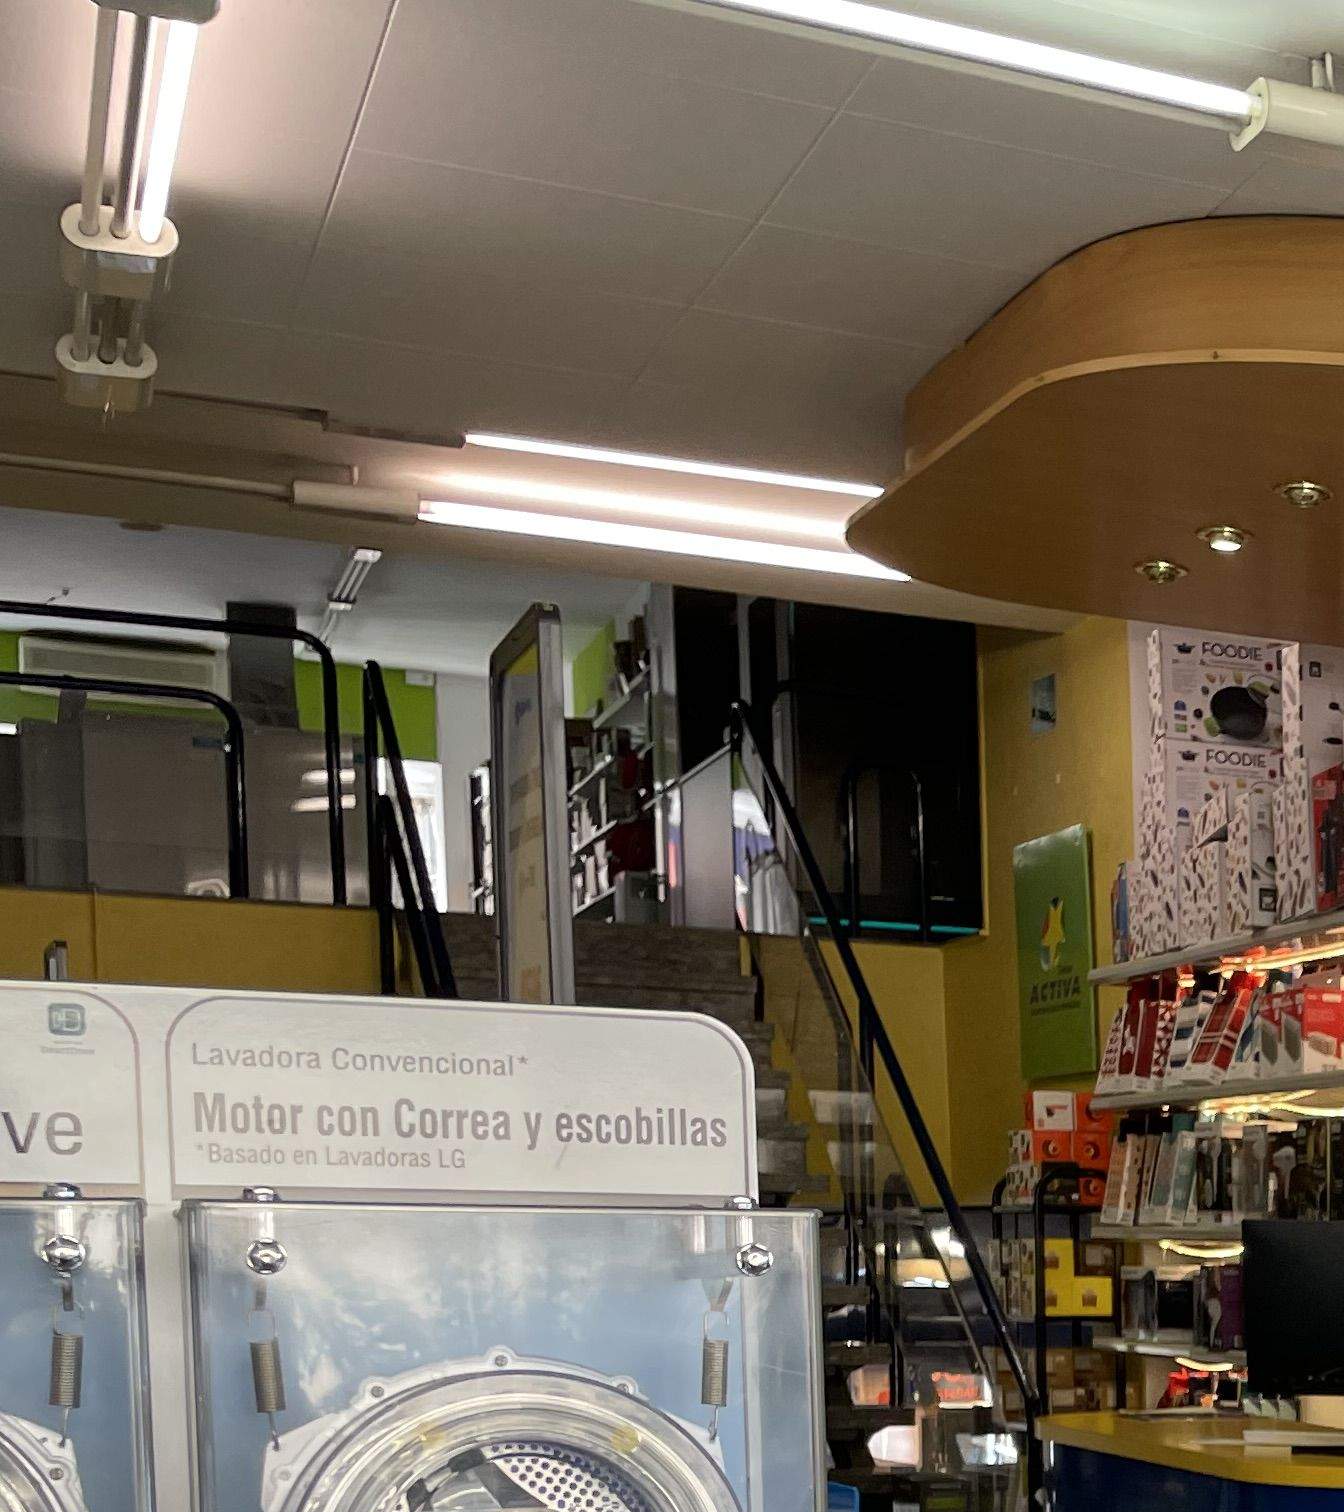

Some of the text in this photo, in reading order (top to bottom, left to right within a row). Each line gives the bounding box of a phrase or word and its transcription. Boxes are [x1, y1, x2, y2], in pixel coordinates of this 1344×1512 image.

[1202, 642, 1263, 661] FOODIE
[1206, 749, 1267, 768] FOODIE
[1030, 976, 1080, 1004] ACTIVA
[191, 1042, 323, 1072] Lavadora
[193, 1090, 728, 1151] Motor con Correa y escobillas
[293, 1145, 467, 1170] en Lavadoras LG
